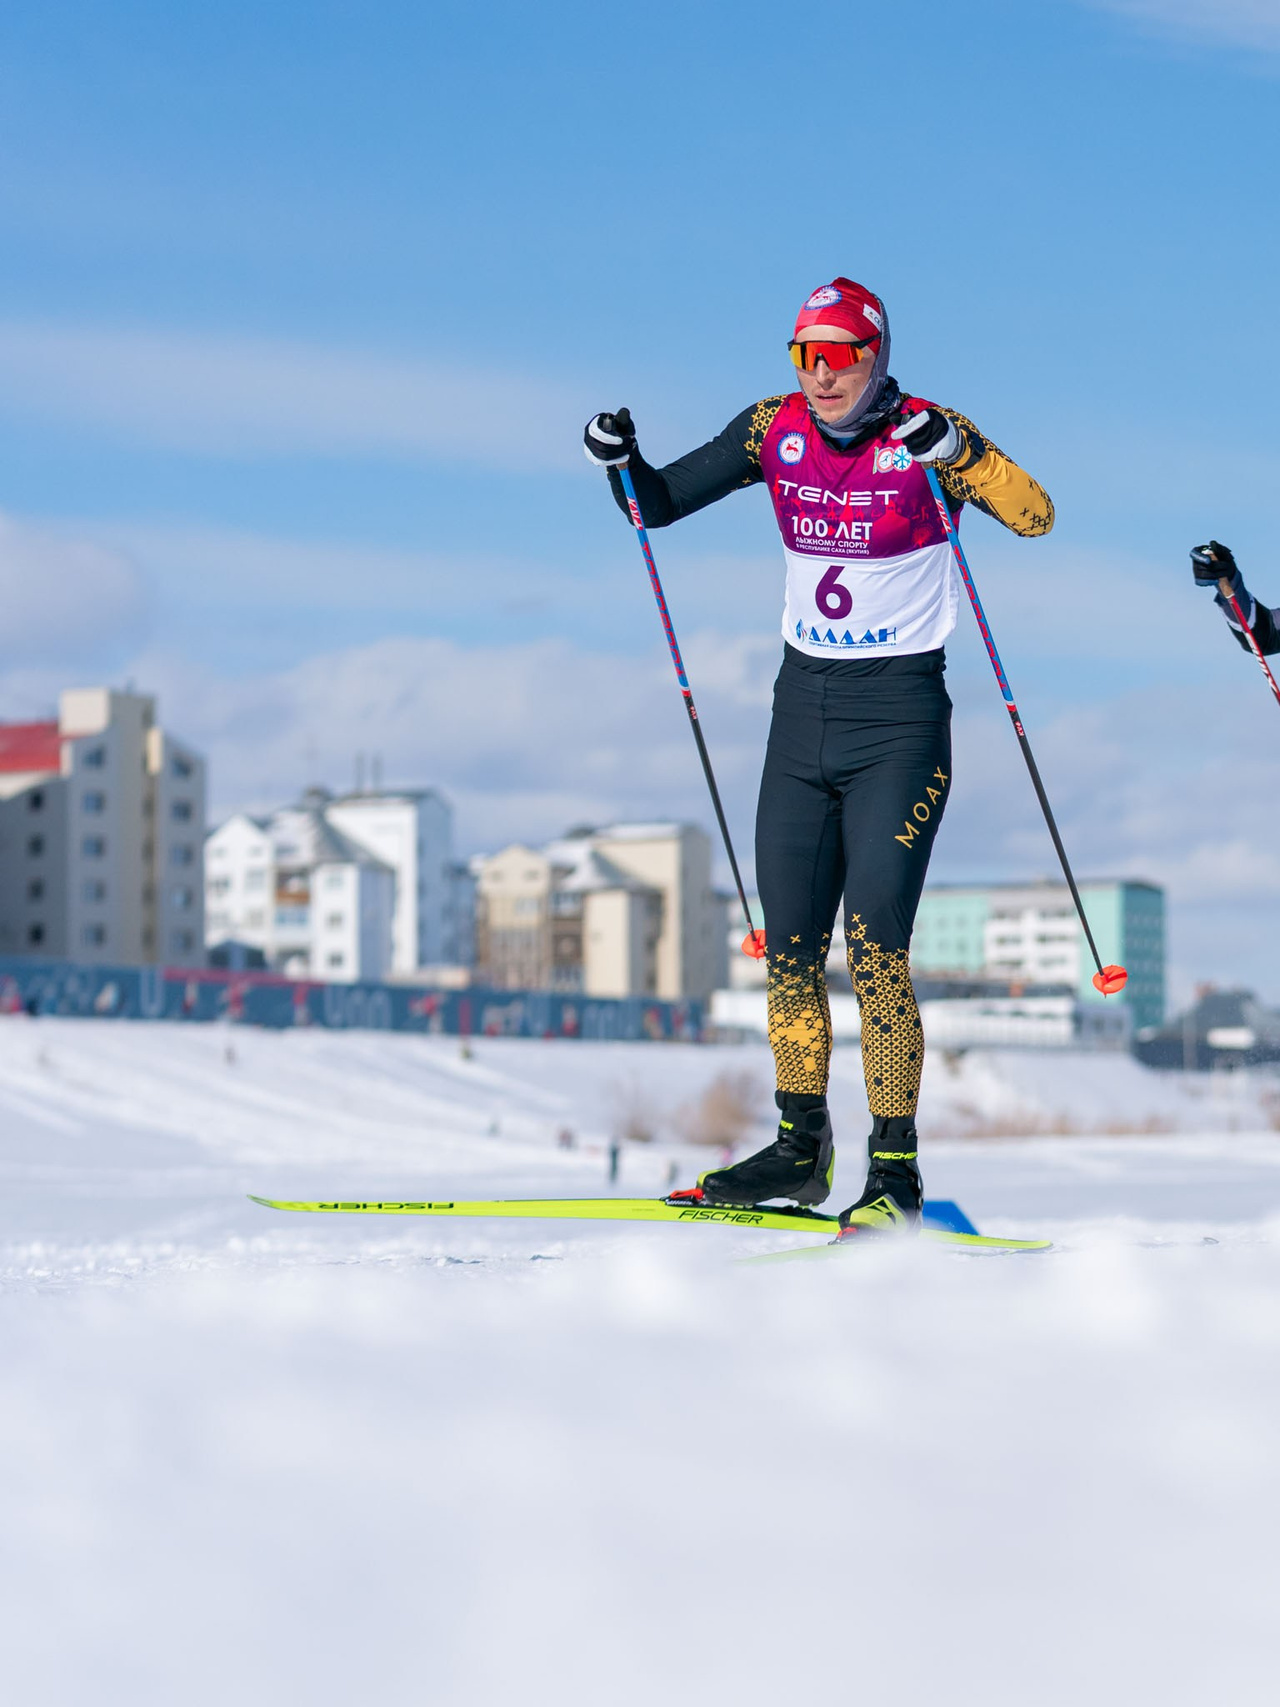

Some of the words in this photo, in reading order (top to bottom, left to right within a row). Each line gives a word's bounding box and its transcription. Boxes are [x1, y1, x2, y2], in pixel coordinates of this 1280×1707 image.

[778, 479, 899, 506] TENET
[791, 516, 828, 538] 100
[834, 521, 873, 541] ЛЕТ
[795, 536, 836, 547] ЛЫЖНОМУ
[837, 540, 868, 549] СПОРТУ
[815, 565, 853, 620] 6
[894, 765, 949, 849] MOAX
[679, 1209, 763, 1225] FISCHER
